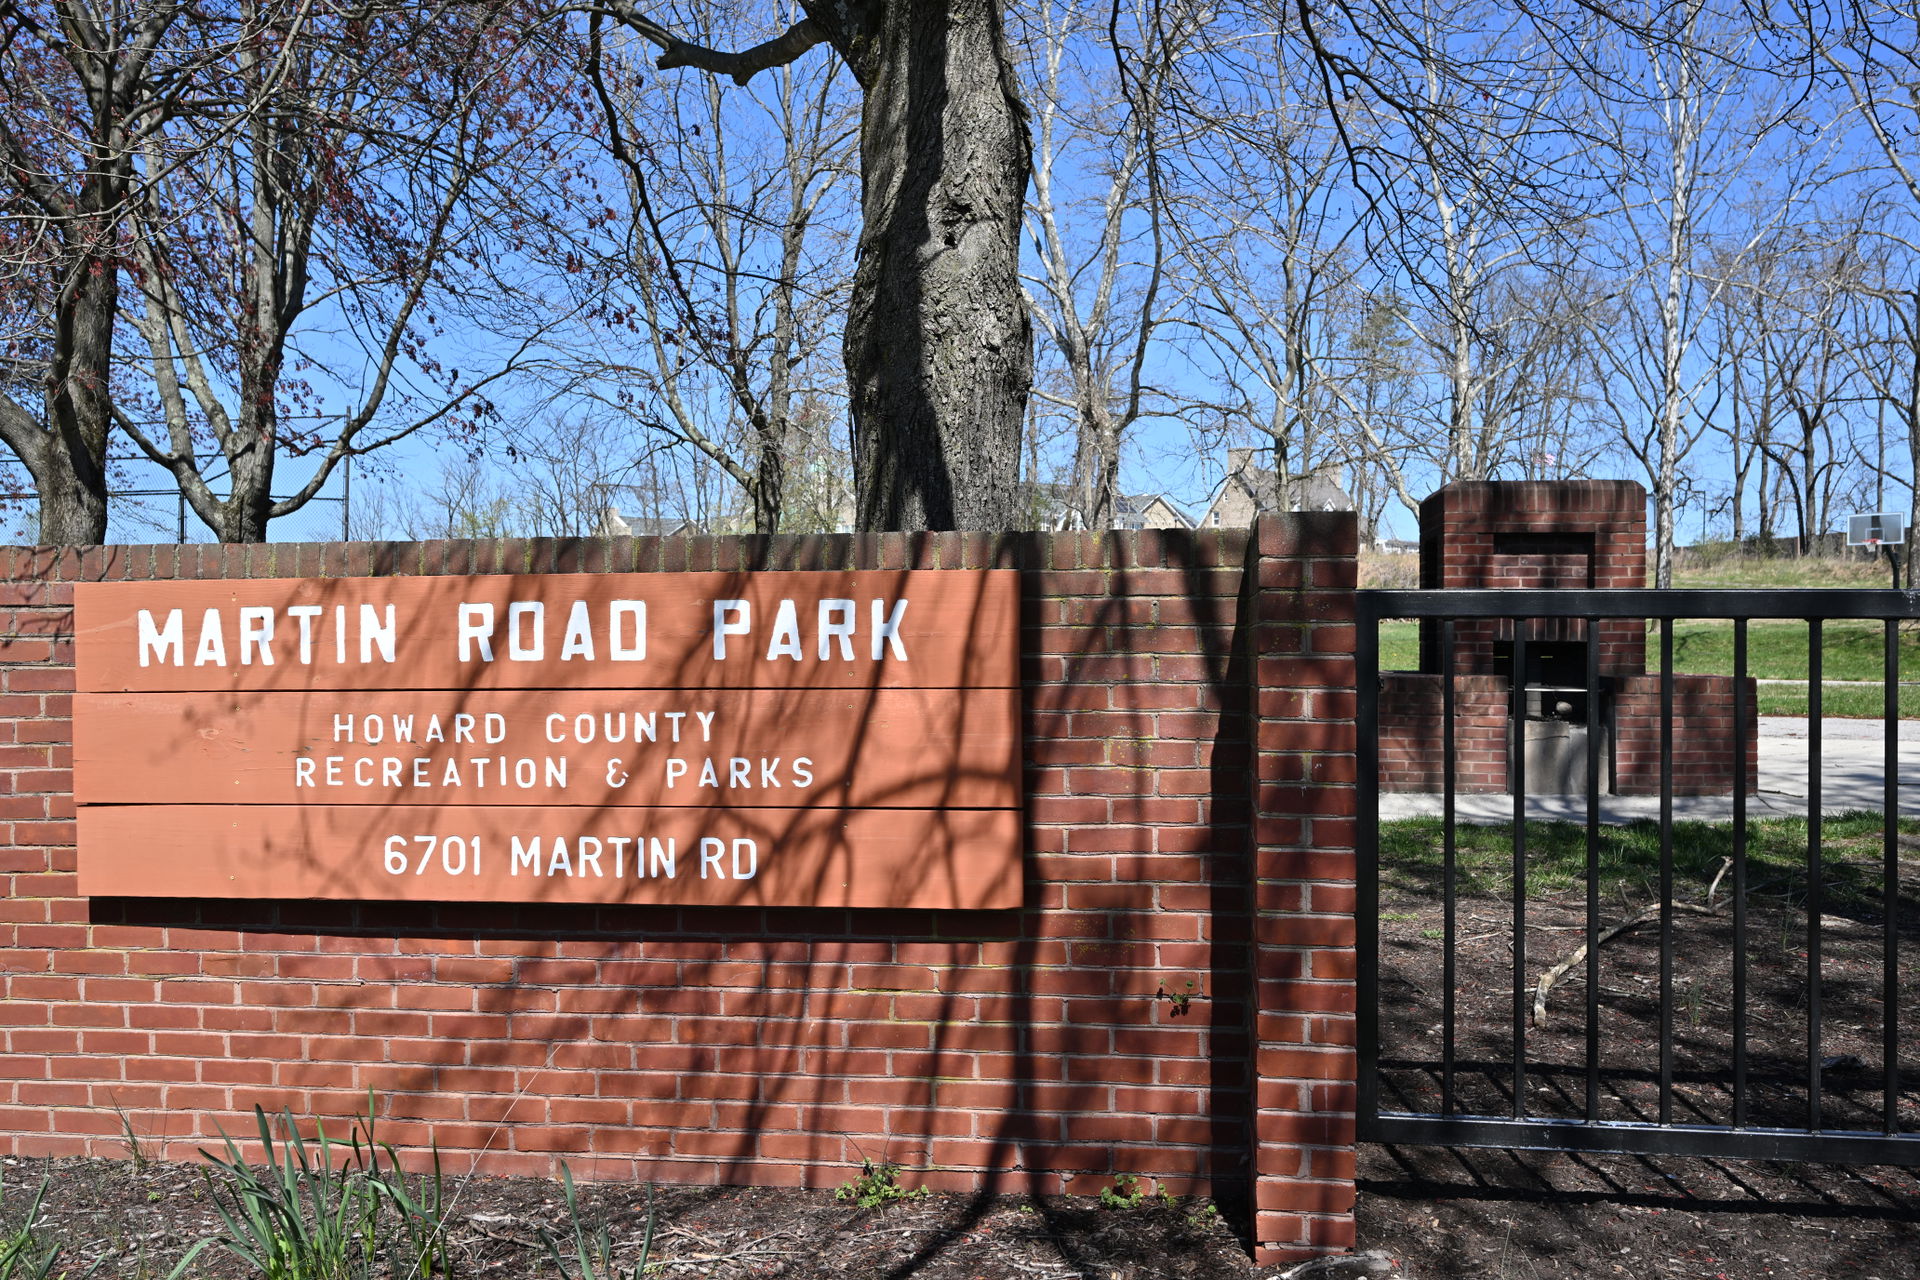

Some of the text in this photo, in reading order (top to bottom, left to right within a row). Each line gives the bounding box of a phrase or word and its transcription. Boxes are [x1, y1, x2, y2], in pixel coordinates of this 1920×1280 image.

[138, 598, 908, 667] MARTIN ROAD PARK
[335, 712, 715, 743] HOWARD COUNTY
[297, 756, 813, 788] RECREATION & PARKS
[385, 835, 757, 879] 6701 MARTIN RD
